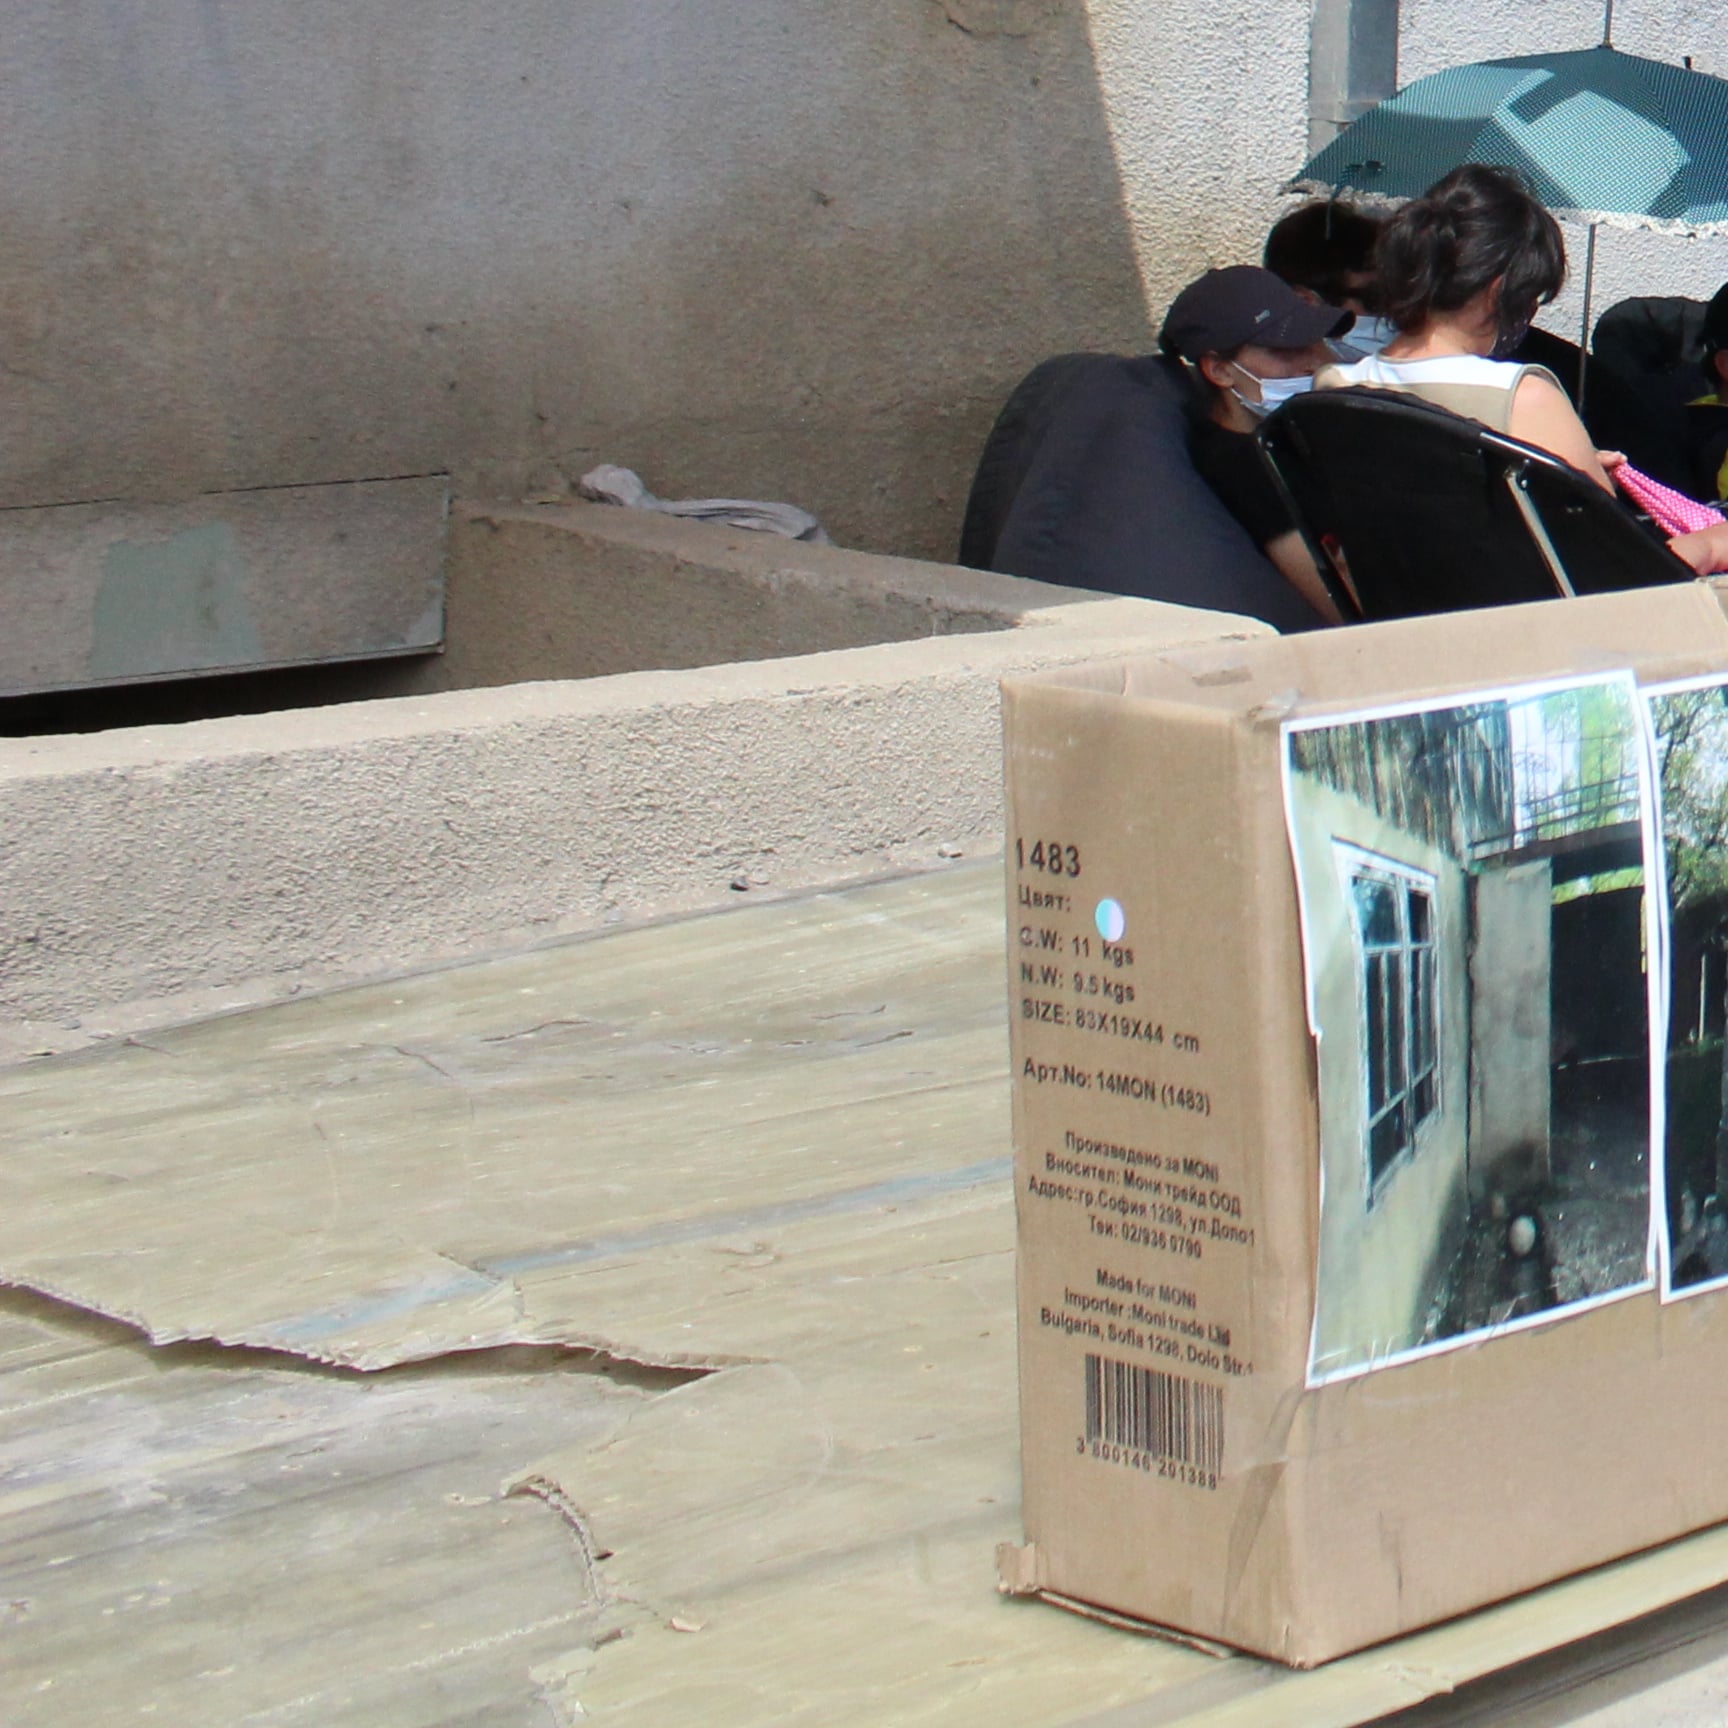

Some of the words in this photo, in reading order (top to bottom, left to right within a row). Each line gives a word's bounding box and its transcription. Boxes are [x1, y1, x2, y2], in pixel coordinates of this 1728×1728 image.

[1016, 837, 1081, 877] 1483
[1072, 935, 1090, 958] 11
[1102, 939, 1134, 968] kgs
[1103, 976, 1135, 1004] kgs
[1022, 998, 1071, 1026] SIZE:
[1173, 1032, 1200, 1053] cm
[1097, 1268, 1134, 1295] Made
[1136, 1278, 1155, 1300] for
